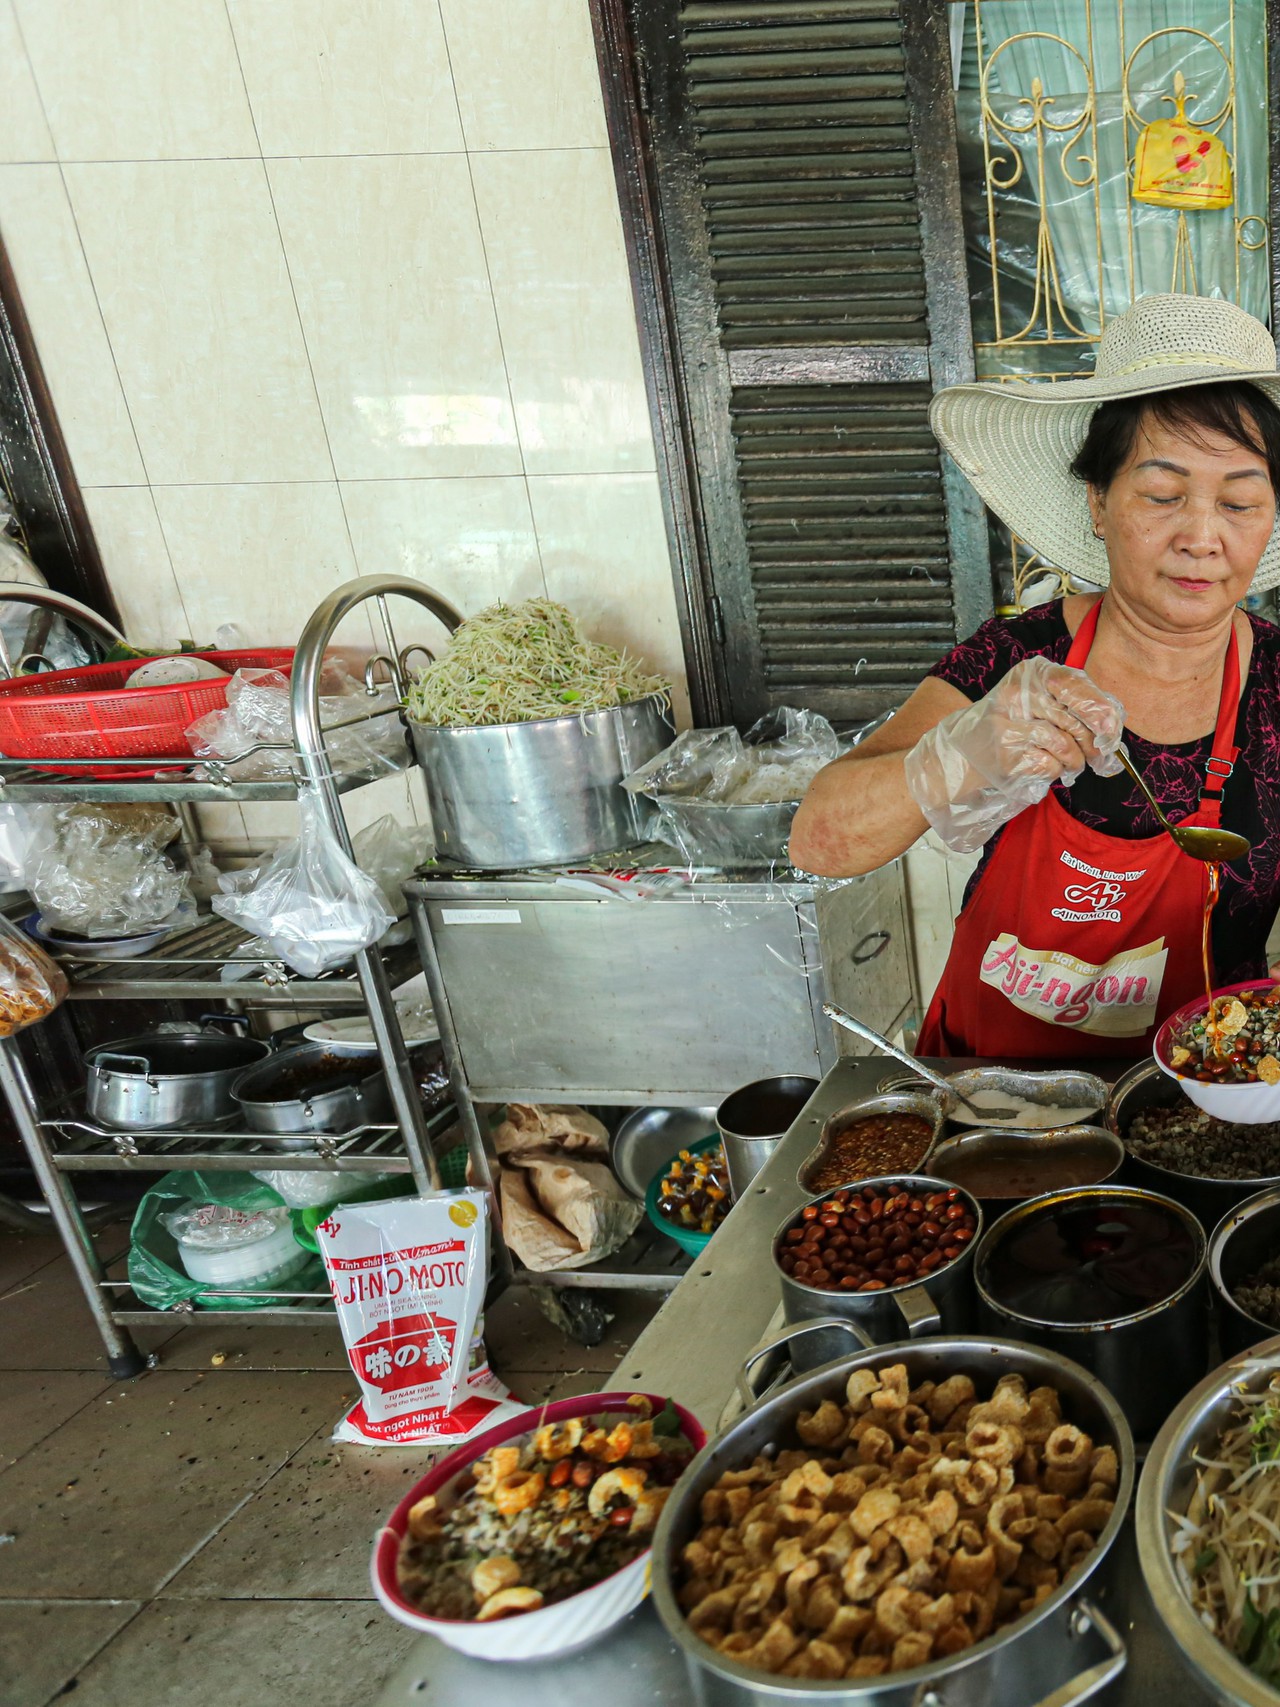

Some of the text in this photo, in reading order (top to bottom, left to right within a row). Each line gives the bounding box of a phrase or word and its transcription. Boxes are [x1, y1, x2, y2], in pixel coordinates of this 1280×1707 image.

[1061, 852, 1076, 867] Eat
[1078, 862, 1101, 878] Well,
[1103, 871, 1124, 880] Live
[411, 1237, 455, 1261] Umami
[365, 1334, 452, 1379] 味の素
[417, 1385, 434, 1393] 1909
[384, 1418, 409, 1433] ngọt
[412, 1410, 440, 1424] Nhật
